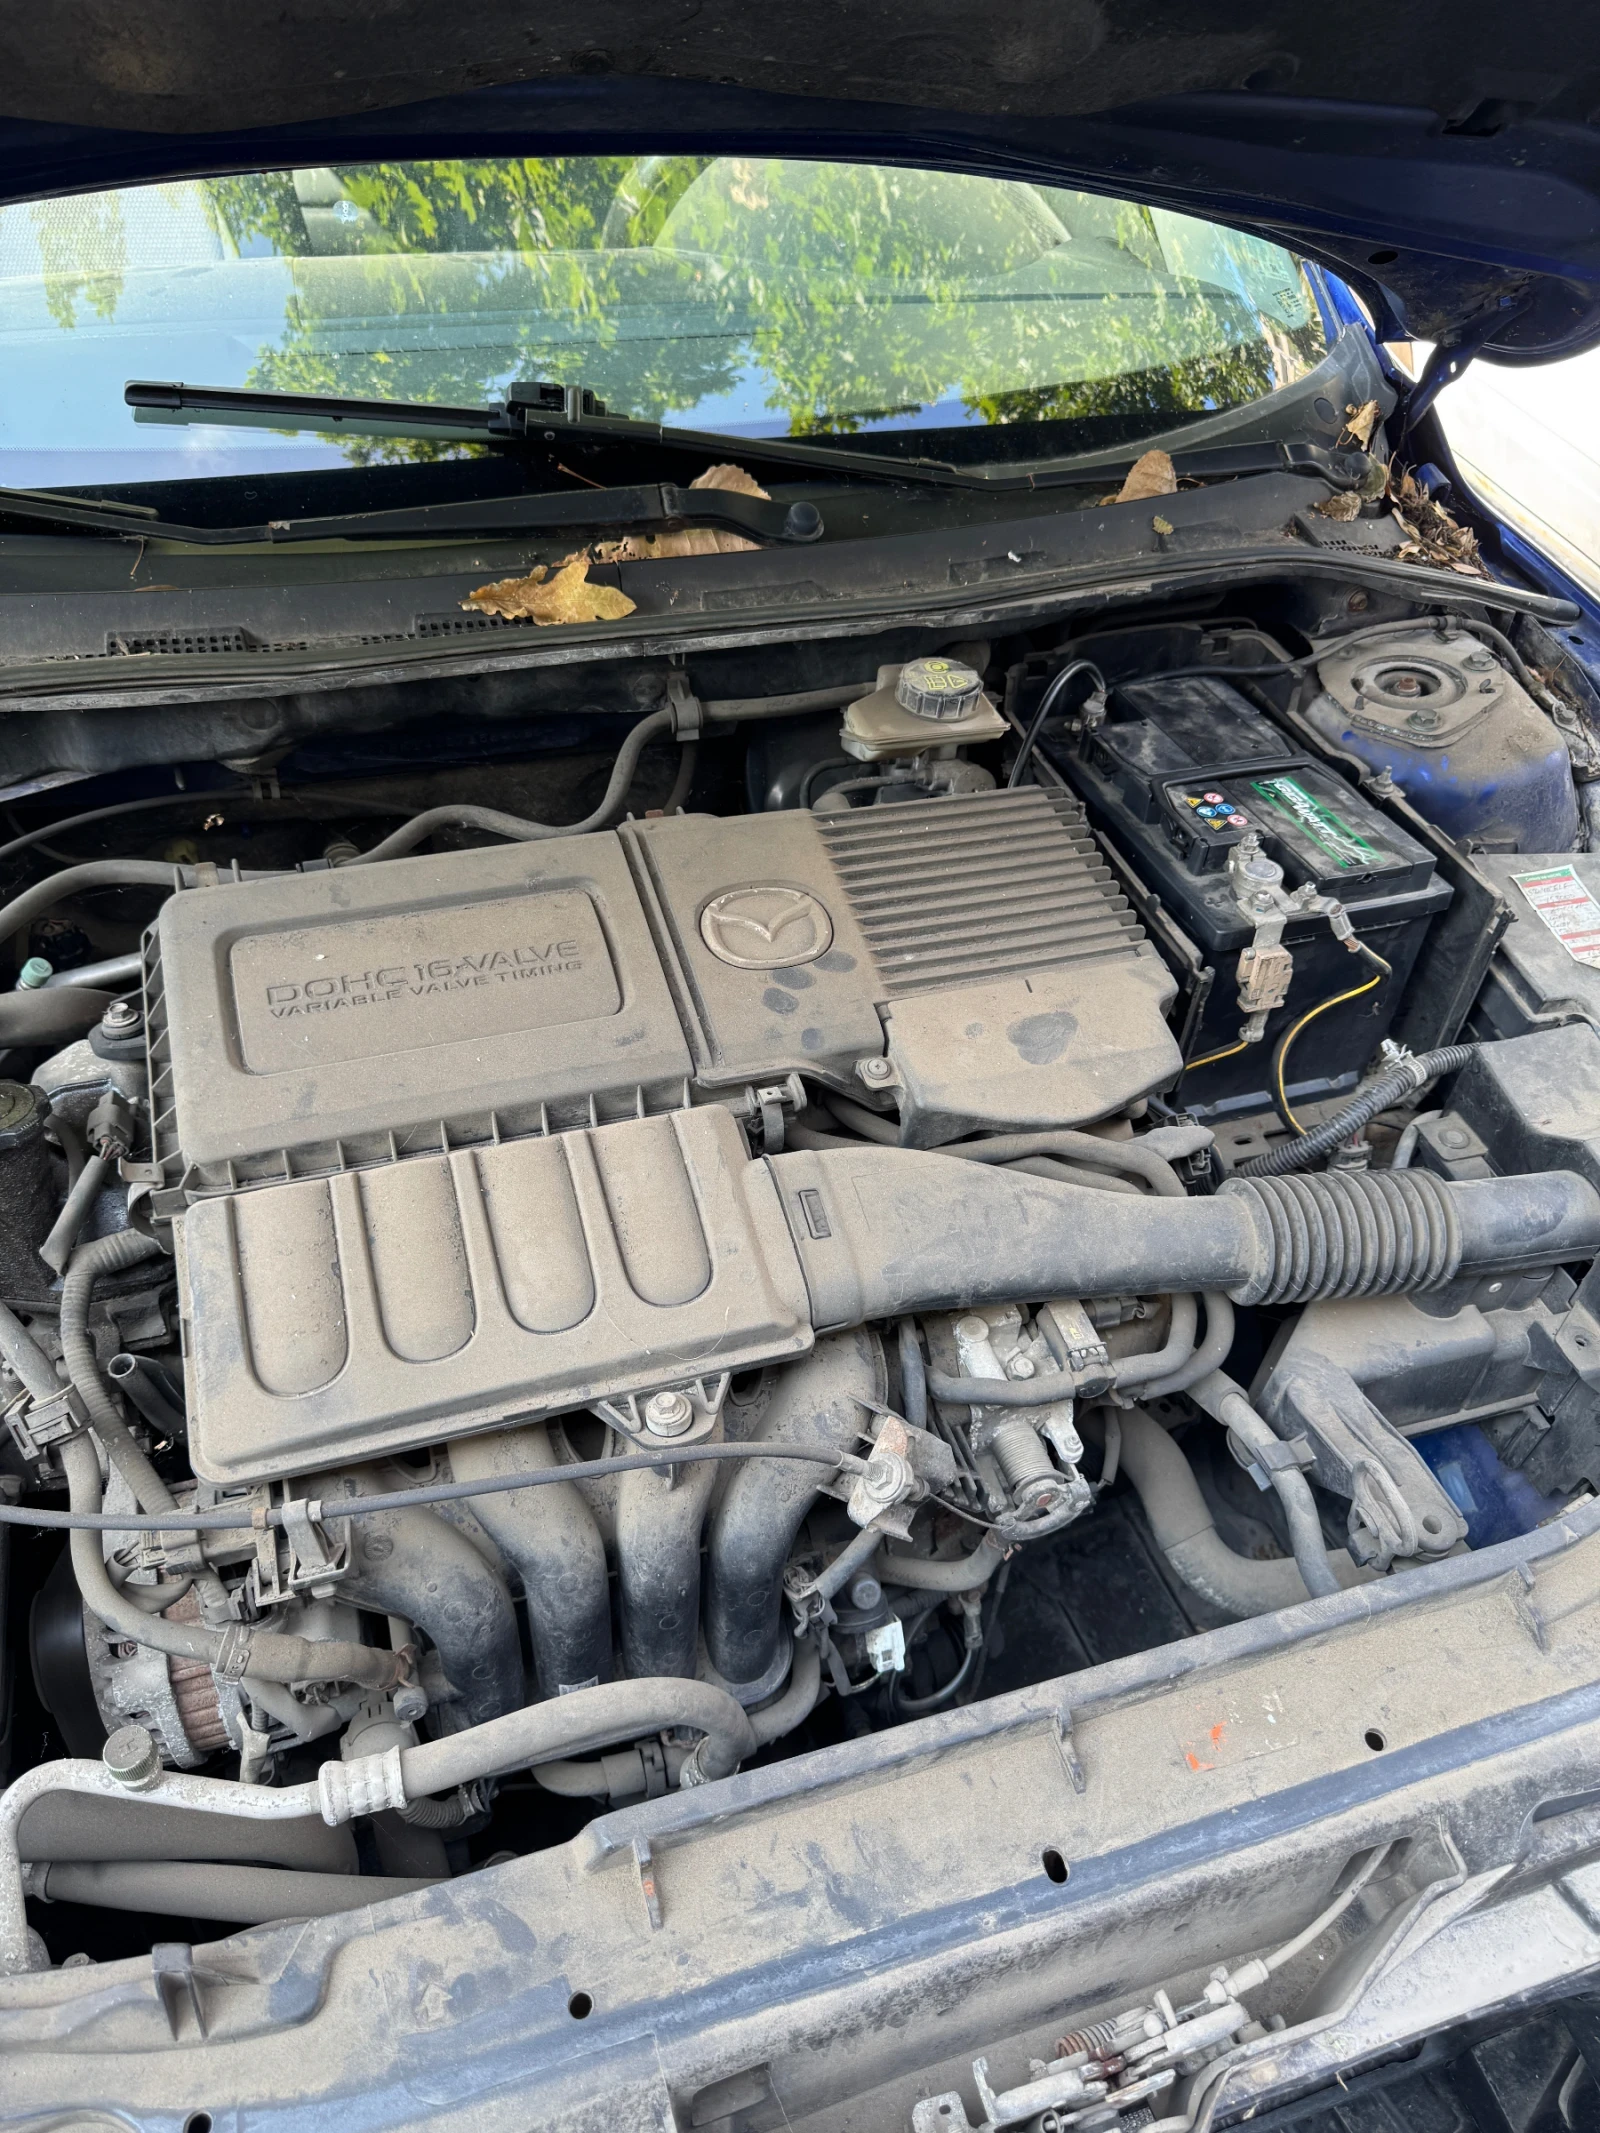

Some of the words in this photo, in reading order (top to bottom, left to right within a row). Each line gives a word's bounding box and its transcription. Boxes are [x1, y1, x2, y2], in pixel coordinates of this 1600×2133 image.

[1274, 780, 1336, 839] GIGAWATT
[266, 967, 409, 1006] DOHC
[413, 939, 580, 982] 16-VALVE
[270, 989, 403, 1019] VARIABLE
[409, 974, 490, 996] VALVE
[495, 959, 583, 983] TIMING
